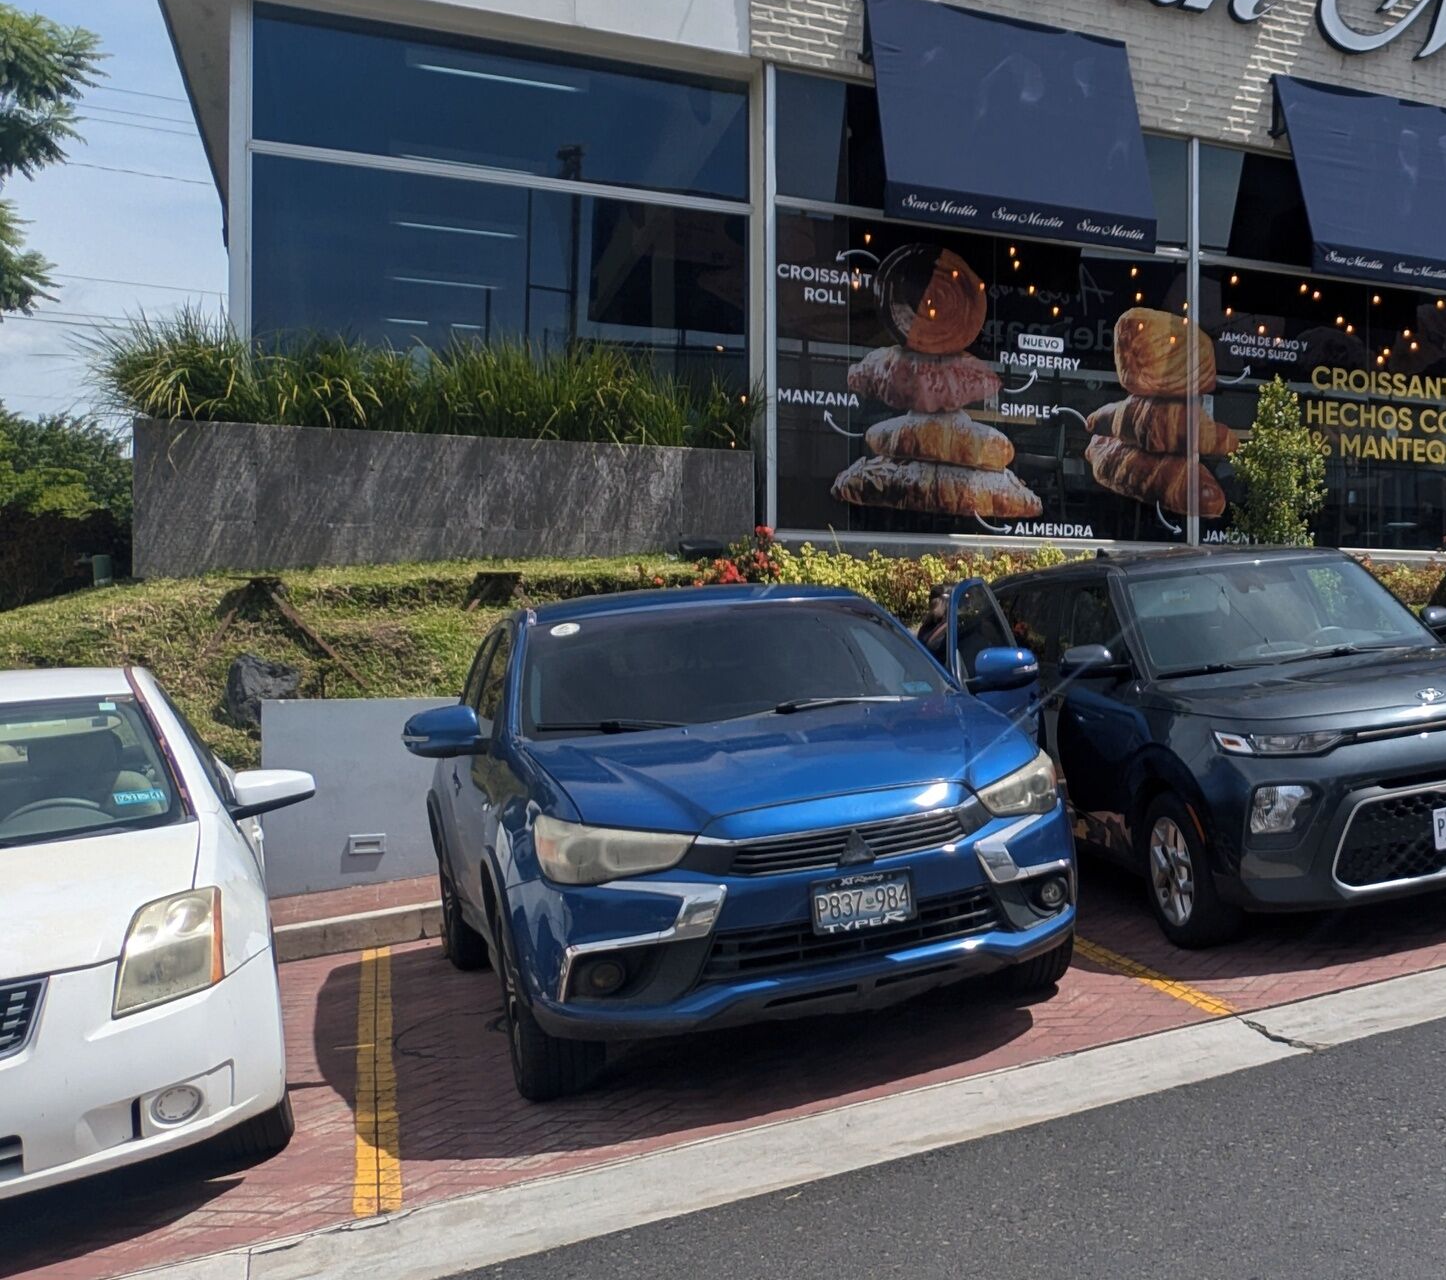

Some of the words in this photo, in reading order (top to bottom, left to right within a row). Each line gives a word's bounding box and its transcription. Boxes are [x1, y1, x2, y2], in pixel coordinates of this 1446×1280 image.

[901, 194, 929, 211] San
[991, 206, 1018, 222] San
[1076, 218, 1101, 234] San
[776, 263, 872, 289] CROISSANT
[804, 286, 846, 305] ROLL
[1022, 336, 1060, 350] NUEVO
[1219, 331, 1256, 346] JAMÓN
[1257, 337, 1271, 347] DE
[1301, 341, 1308, 352] Y
[999, 351, 1081, 372] RASPBERRY
[1230, 344, 1266, 359] QUESO
[1267, 349, 1297, 362] SUIZO
[777, 388, 859, 408] MANZANA
[1000, 403, 1051, 419] SIMPLE
[1306, 399, 1414, 432] HECHOS
[1014, 522, 1094, 538] ALMENDRA
[1437, 817, 1445, 837] P
